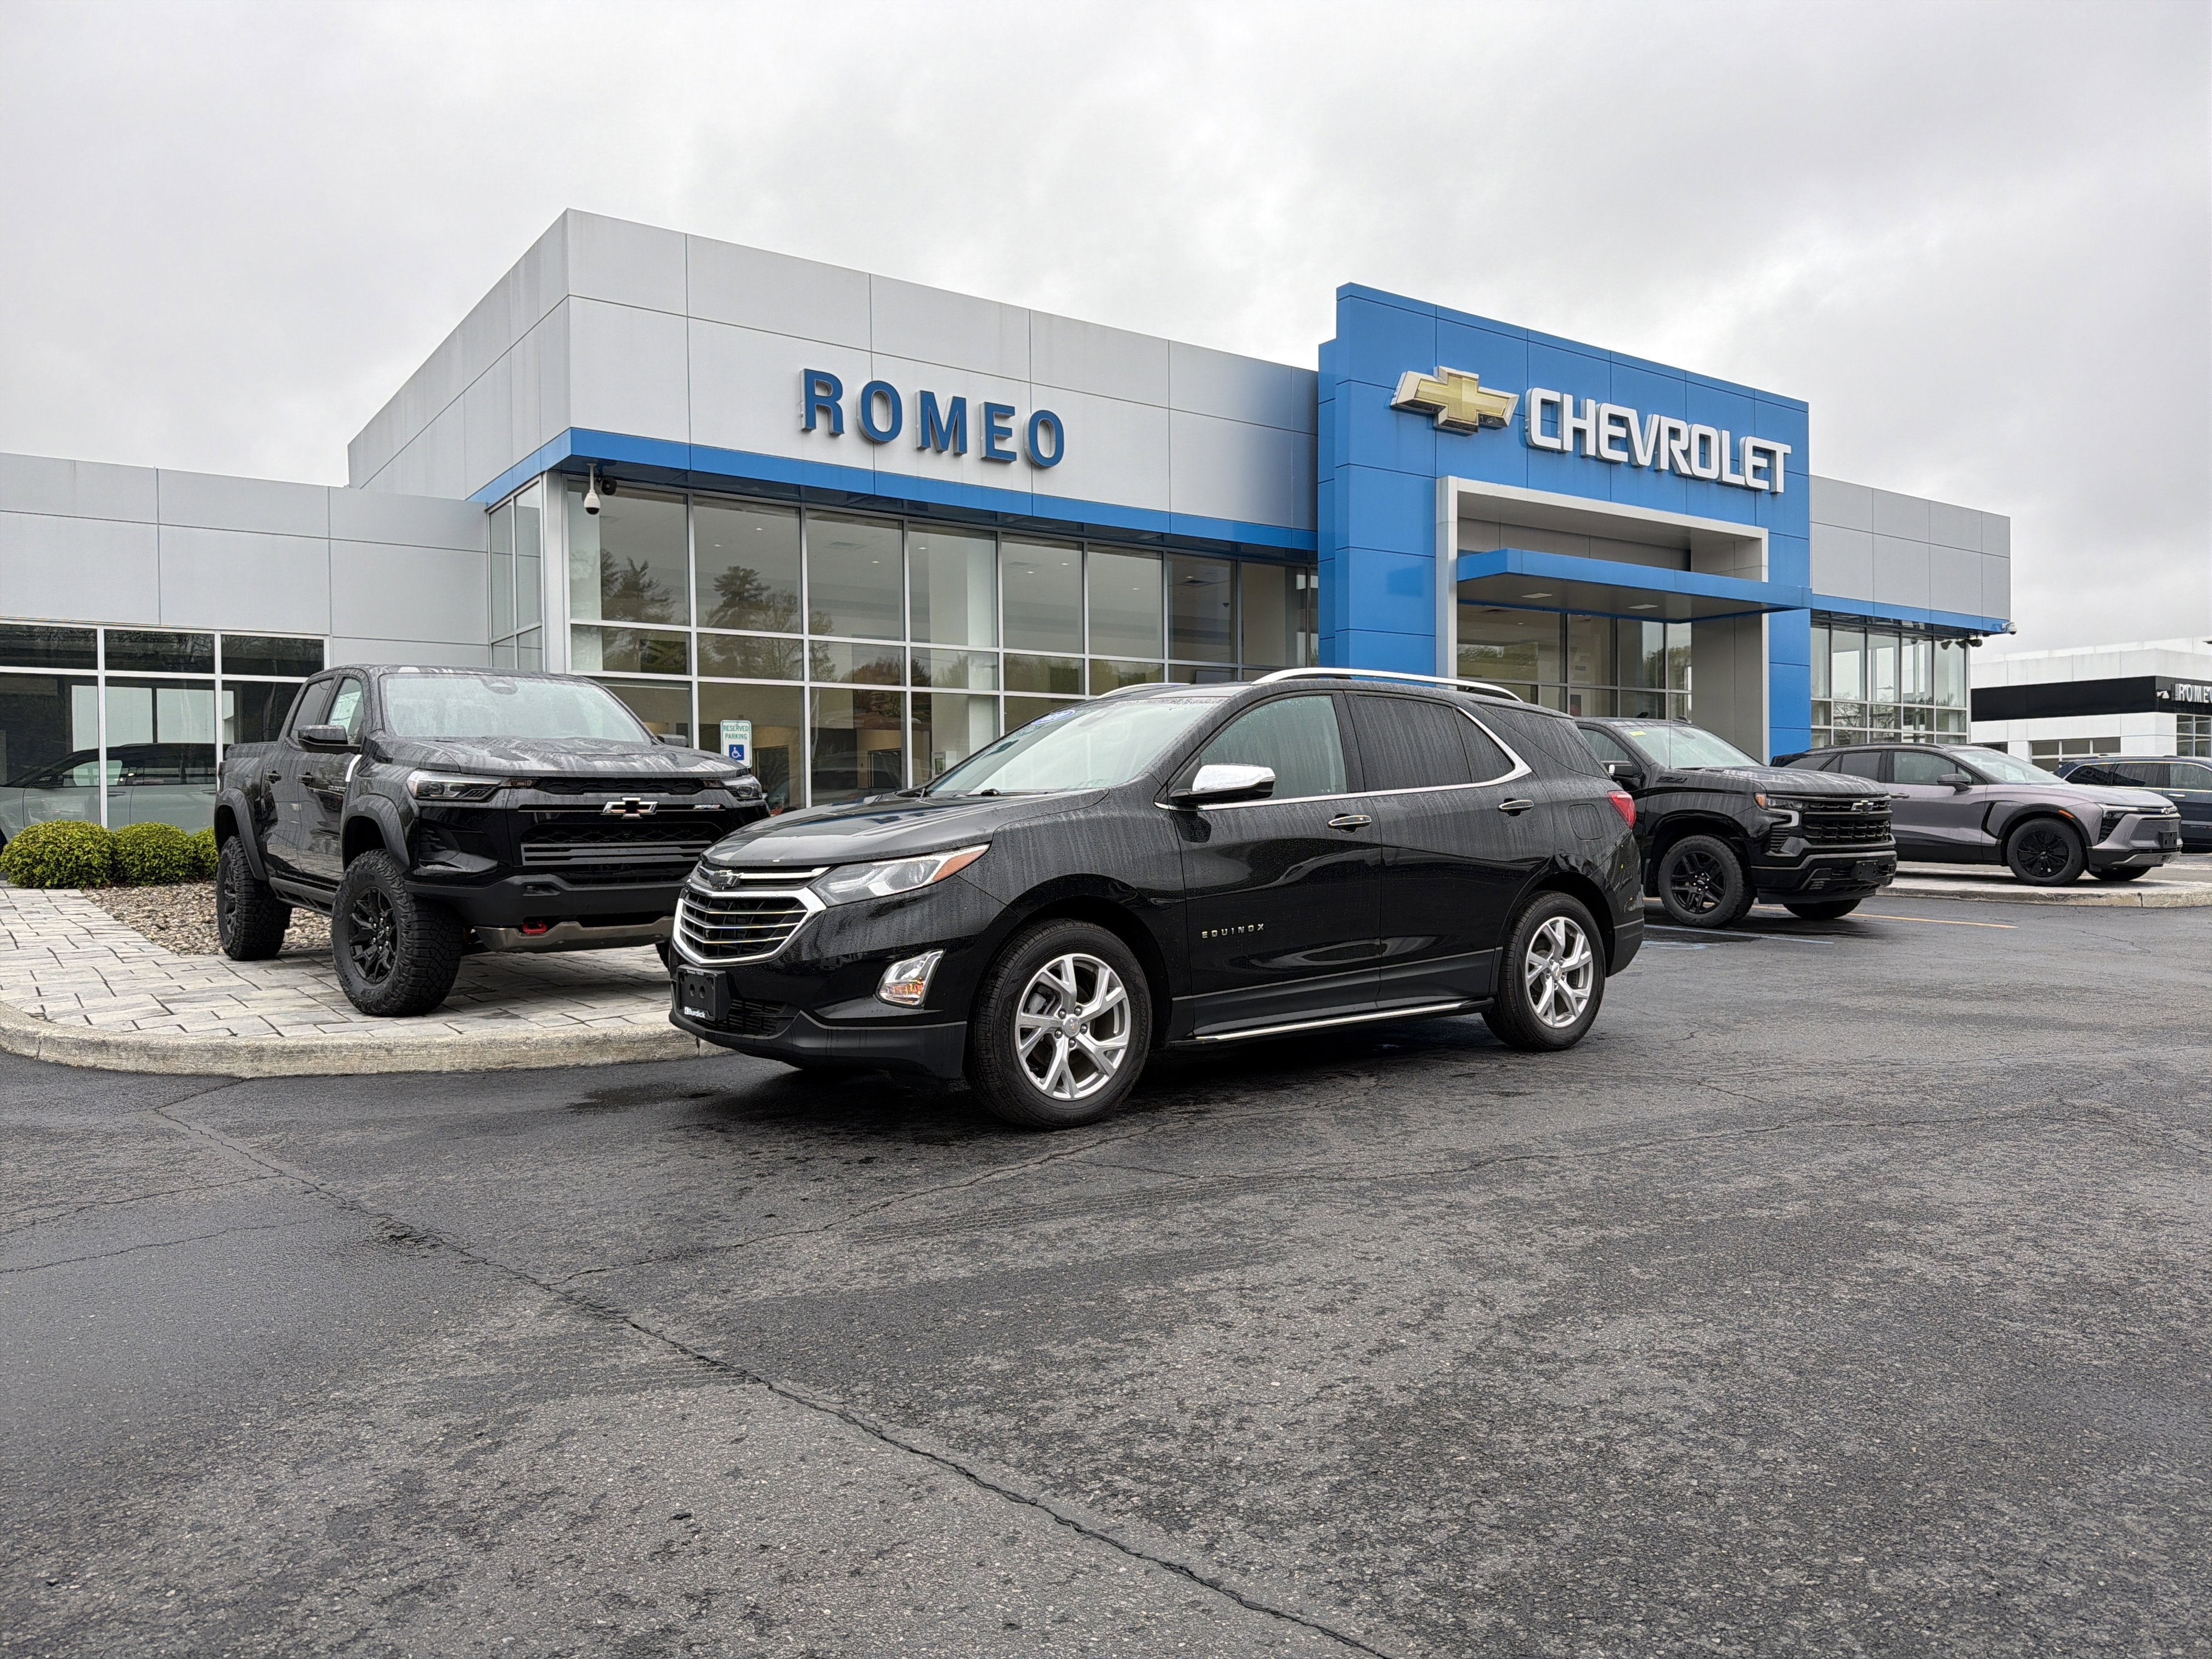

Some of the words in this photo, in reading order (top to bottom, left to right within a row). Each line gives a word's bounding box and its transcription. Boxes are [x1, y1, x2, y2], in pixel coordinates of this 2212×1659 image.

[800, 368, 1065, 468] ROMEO
[1525, 387, 1791, 493] CHEVROLET
[2176, 684, 2212, 703] ROME
[1202, 923, 1264, 939] EQUINOX
